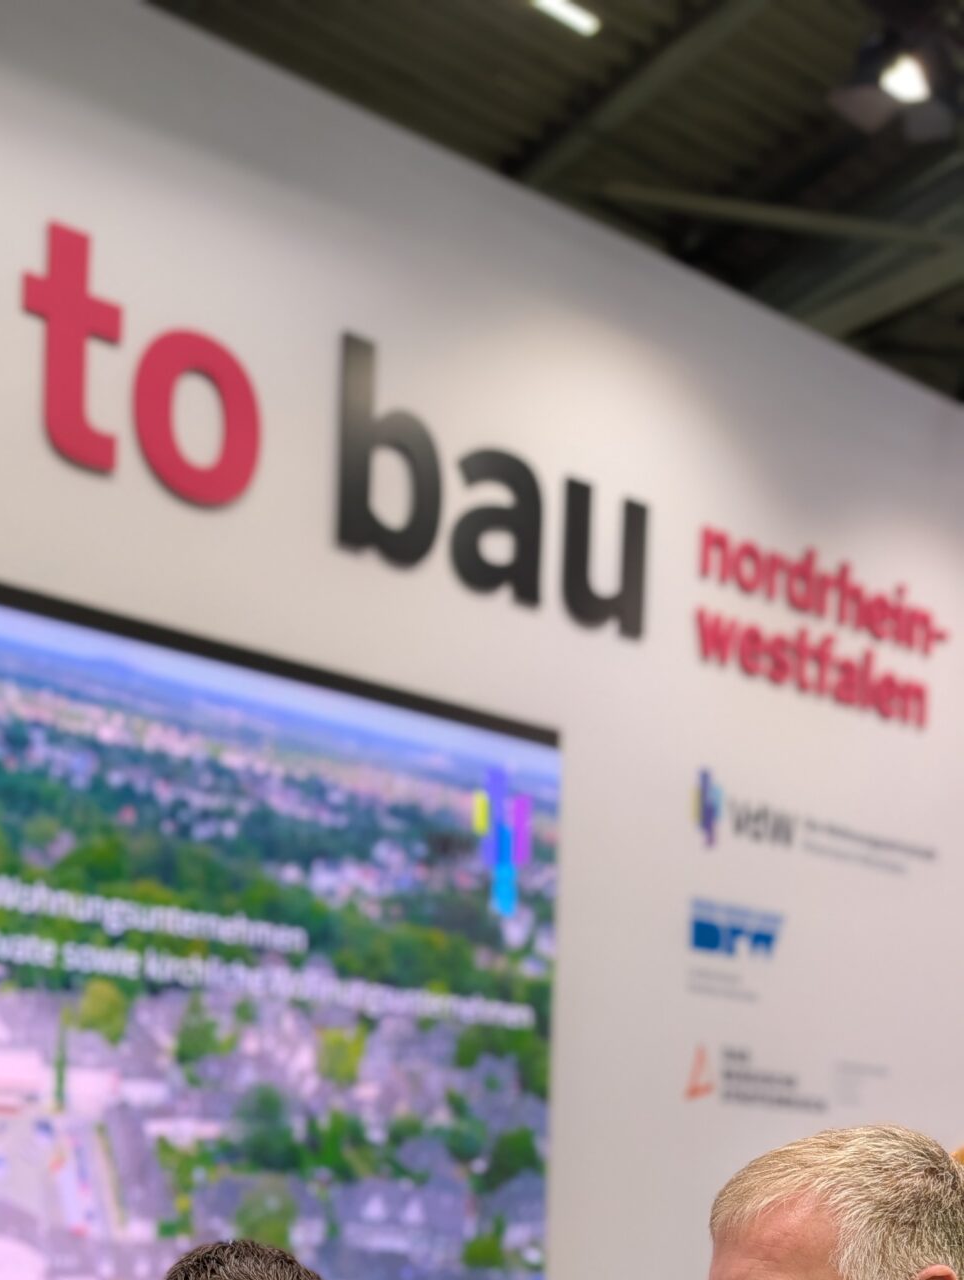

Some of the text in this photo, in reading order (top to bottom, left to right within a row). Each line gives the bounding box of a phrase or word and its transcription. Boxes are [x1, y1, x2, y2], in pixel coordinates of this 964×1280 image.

[21, 219, 262, 512] to
[335, 329, 649, 640] bau
[700, 525, 948, 657] nordrhein-
[696, 607, 928, 732] westfalen
